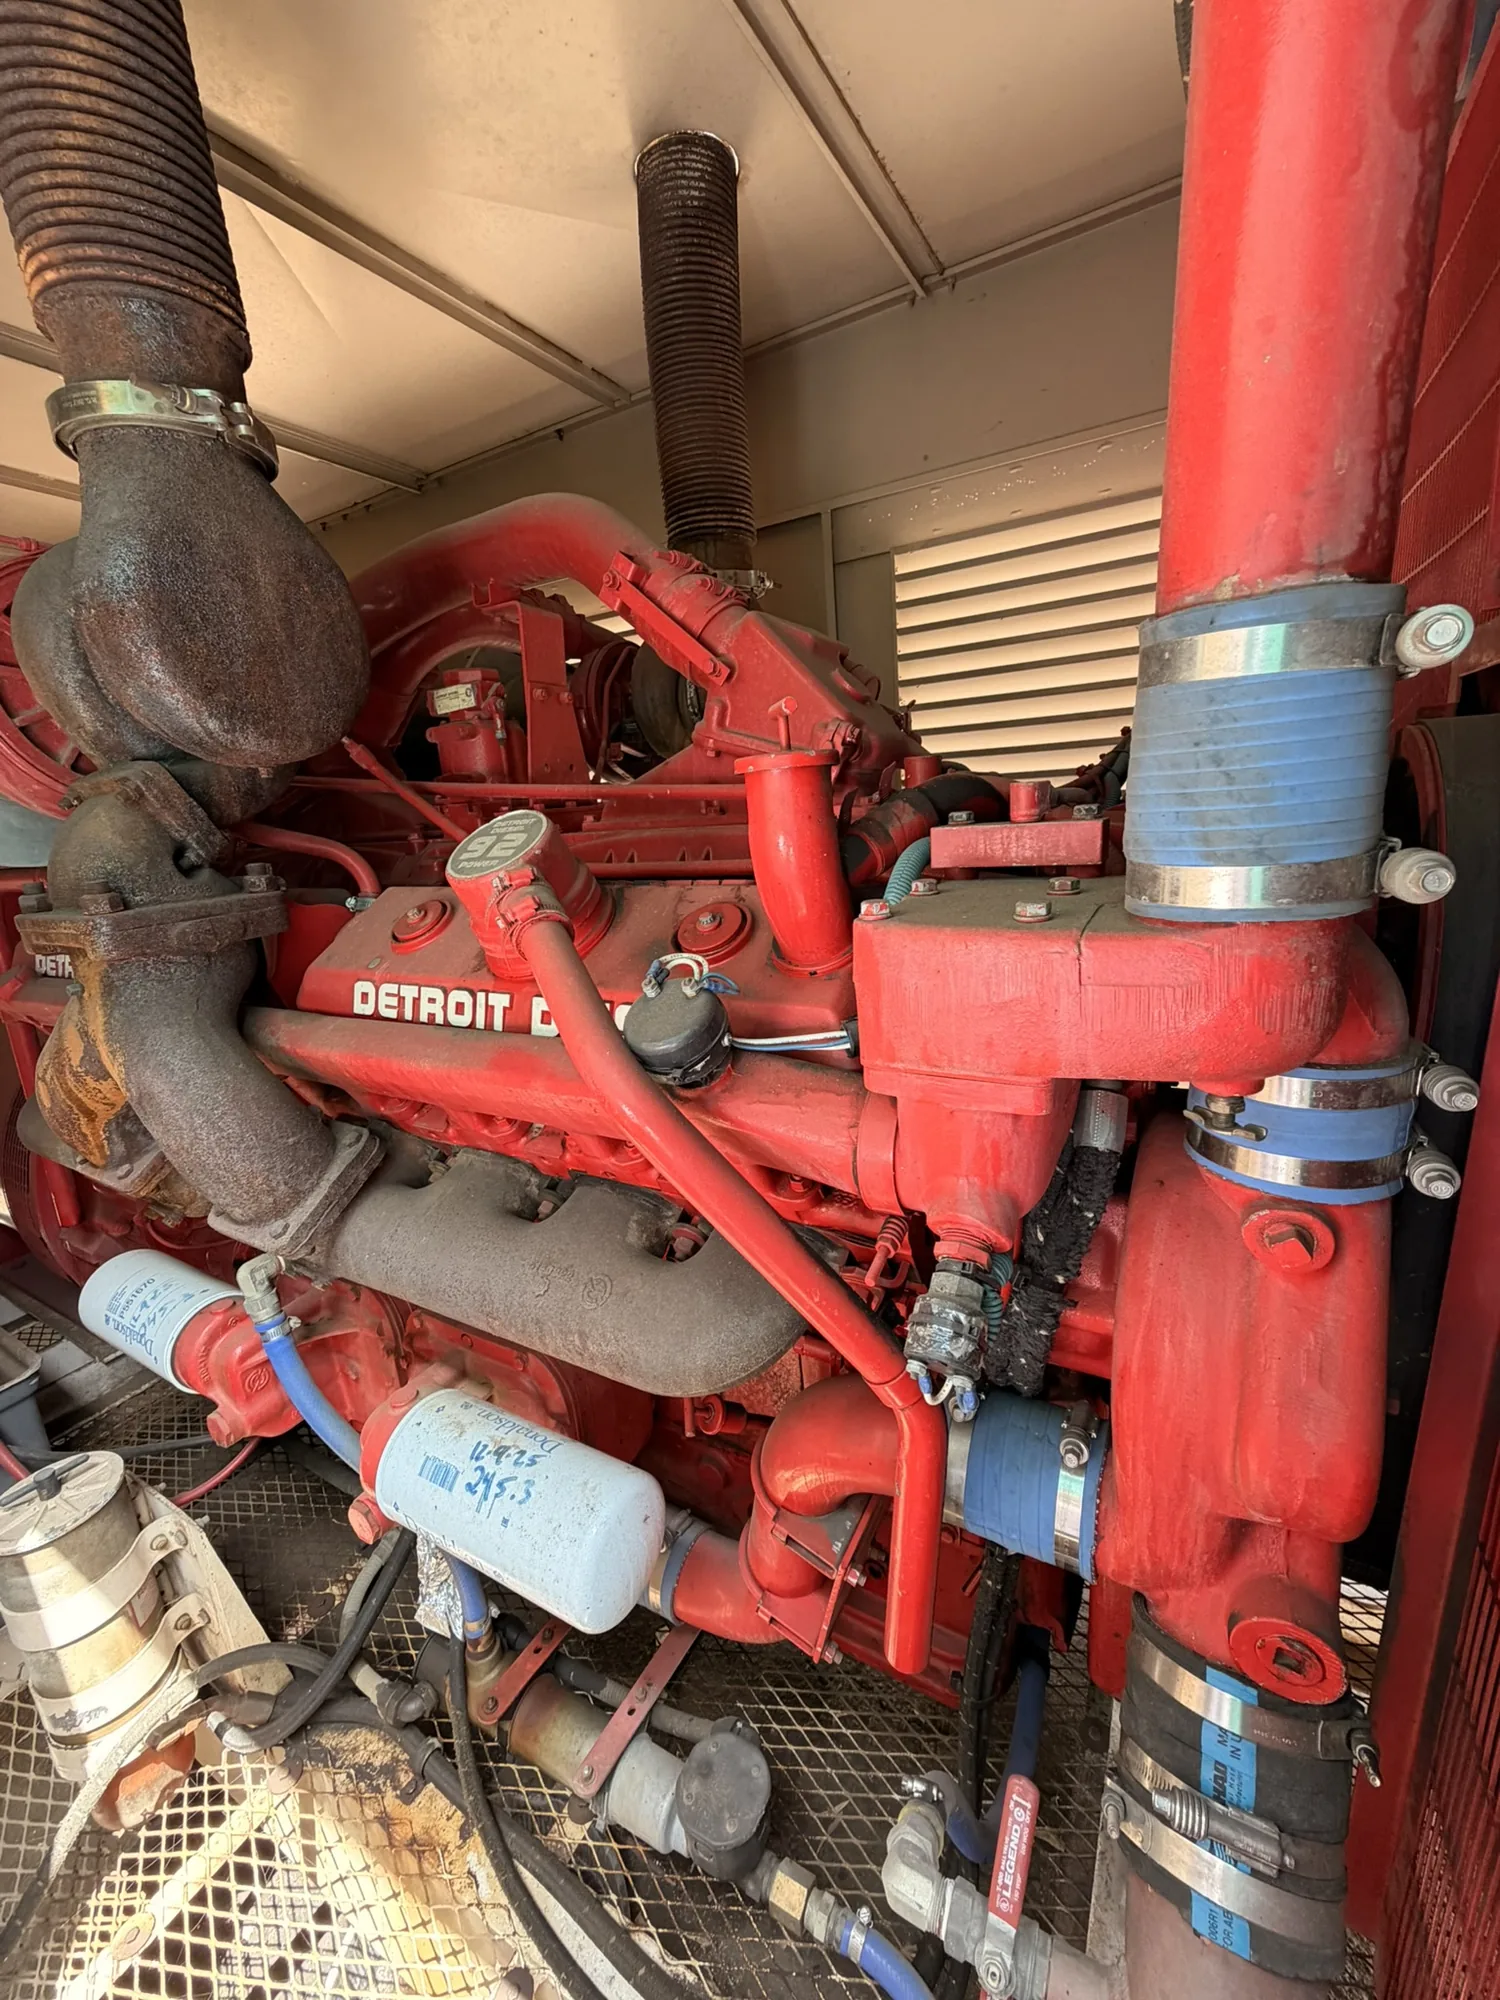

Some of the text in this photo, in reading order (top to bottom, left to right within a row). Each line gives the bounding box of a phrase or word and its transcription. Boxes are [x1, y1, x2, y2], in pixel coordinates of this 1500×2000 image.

[493, 818, 537, 828] DETROIT
[459, 833, 528, 860] 92
[458, 860, 500, 868] POWER
[353, 980, 511, 1032] DETROIT
[119, 1278, 156, 1320] P551670
[1230, 1745, 1241, 1760] IN
[1002, 1824, 1021, 1897] LEGEND
